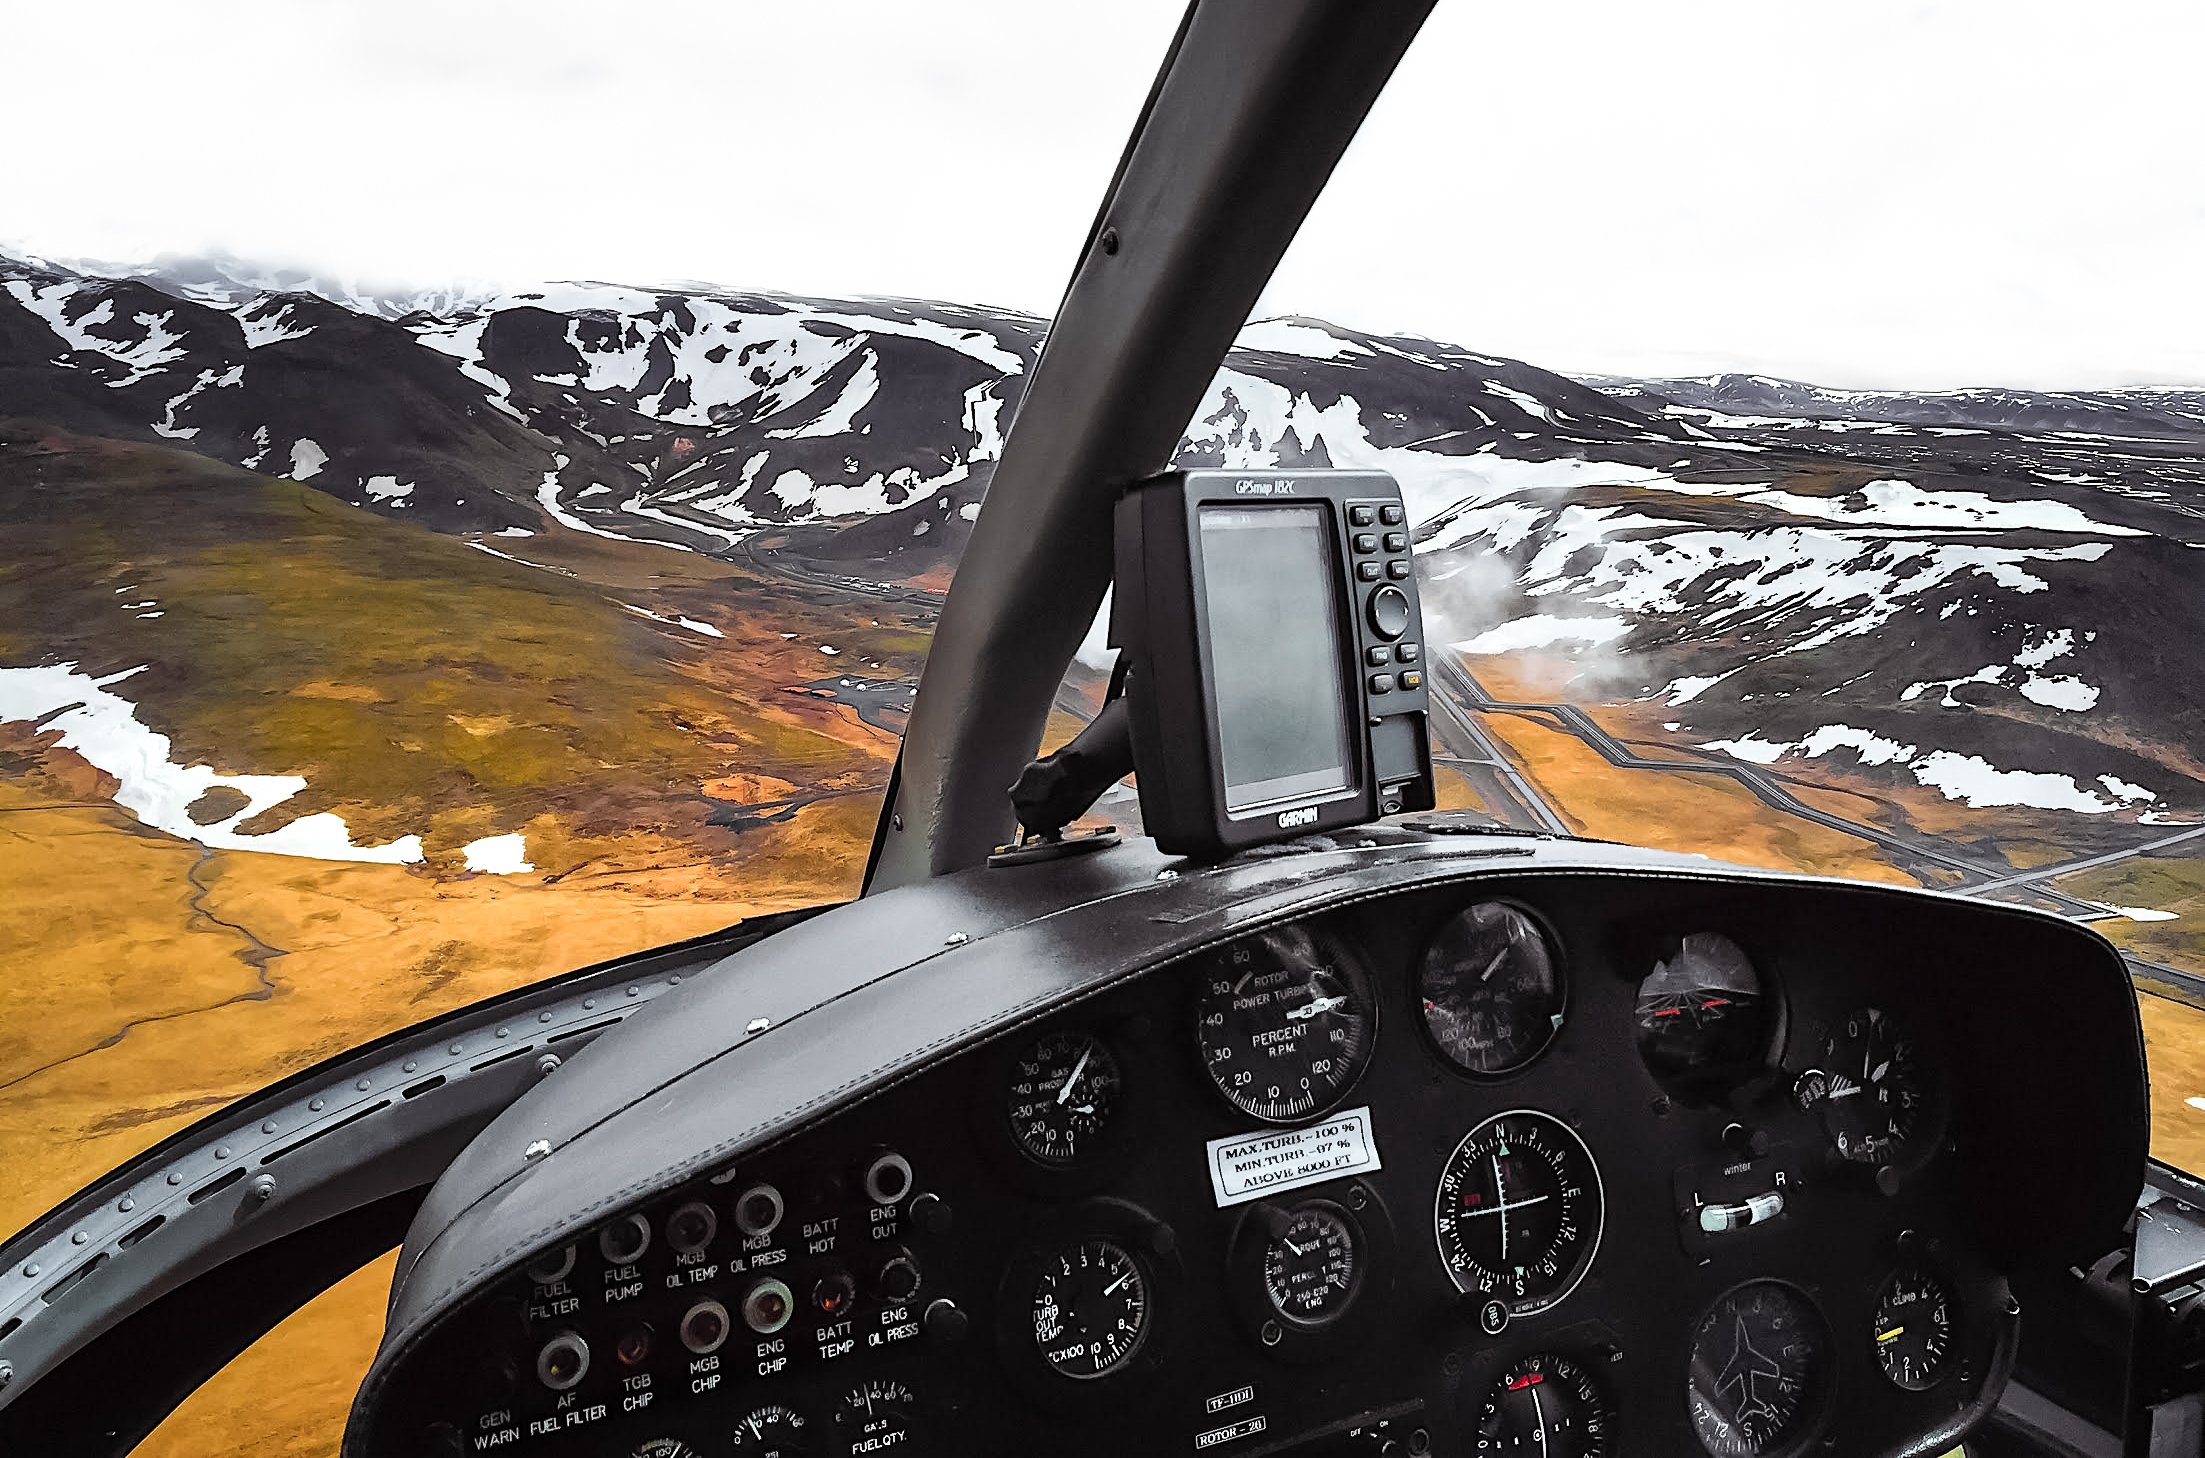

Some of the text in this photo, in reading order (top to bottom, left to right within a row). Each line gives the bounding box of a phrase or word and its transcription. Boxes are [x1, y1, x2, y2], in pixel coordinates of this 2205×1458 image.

[1235, 479, 1273, 497] GPSmap
[1278, 806, 1318, 828] GARMIN
[1233, 992, 1271, 1011] POWER
[1206, 1012, 1224, 1028] 40
[1252, 1023, 1310, 1048] PERCENT
[1329, 1028, 1345, 1043] 110
[1213, 1047, 1232, 1062] 30
[1312, 1058, 1332, 1075] 120
[1234, 1071, 1253, 1087] 20
[1300, 1076, 1310, 1091] 0
[1267, 1086, 1281, 1099] 10
[1019, 1104, 1033, 1118] 30
[1031, 1120, 1046, 1135] 20
[1046, 1129, 1057, 1142] 10
[1066, 1130, 1074, 1142] 0
[1496, 1123, 1506, 1139] N
[1461, 1139, 1478, 1159] 33
[1865, 1135, 1875, 1153] 5
[1243, 1168, 1294, 1188] ABOVE
[1723, 1162, 1752, 1177] winter
[1775, 1171, 1786, 1186] R
[1567, 1186, 1582, 1200] E
[1694, 1192, 1704, 1207] L
[869, 1204, 896, 1222] ENG
[802, 1216, 839, 1239] BATT
[871, 1223, 898, 1240] OUT
[742, 1232, 771, 1253] MGB
[808, 1236, 836, 1255] HOT
[676, 1250, 706, 1268] MGB
[730, 1248, 787, 1274] OIL PRESS
[1080, 1255, 1088, 1268] 3
[604, 1263, 640, 1284] FUEL
[666, 1264, 719, 1289] OIL TEMP
[1063, 1263, 1071, 1276] 2
[533, 1280, 573, 1300] FUEL
[605, 1281, 643, 1304] PUMP
[1514, 1279, 1525, 1297] S
[529, 1297, 580, 1321] FILTER
[1044, 1294, 1053, 1306] 0
[1125, 1298, 1132, 1311] 7
[880, 1307, 908, 1326] ENG
[1033, 1303, 1059, 1323] TURB
[1486, 1305, 1500, 1328] OBS
[816, 1320, 852, 1343] BATT
[1035, 1316, 1056, 1333] OUT
[1118, 1318, 1126, 1331] 8
[867, 1322, 920, 1348] OIL PRESS
[1106, 1333, 1115, 1345] 9
[756, 1338, 785, 1358] ENG
[818, 1338, 855, 1360] TEMP
[1090, 1341, 1102, 1356] 10
[1926, 1338, 1934, 1351] 4
[689, 1355, 720, 1376] MGB
[757, 1357, 787, 1377] CHIP
[1902, 1356, 1911, 1370] 2
[622, 1373, 652, 1393] TGB
[690, 1373, 721, 1395] CHIP
[1504, 1372, 1514, 1386] 6
[556, 1391, 577, 1411] AF
[622, 1391, 655, 1413] CHIP
[478, 1408, 511, 1430] GEN
[529, 1403, 607, 1438] FUEL FILTER
[766, 1413, 779, 1424] 40
[792, 1416, 804, 1428] 60
[473, 1426, 520, 1452] WARN
[734, 1436, 742, 1445] 0
[1199, 1426, 1238, 1446] ROTOR
[852, 1438, 884, 1455] FUEL
